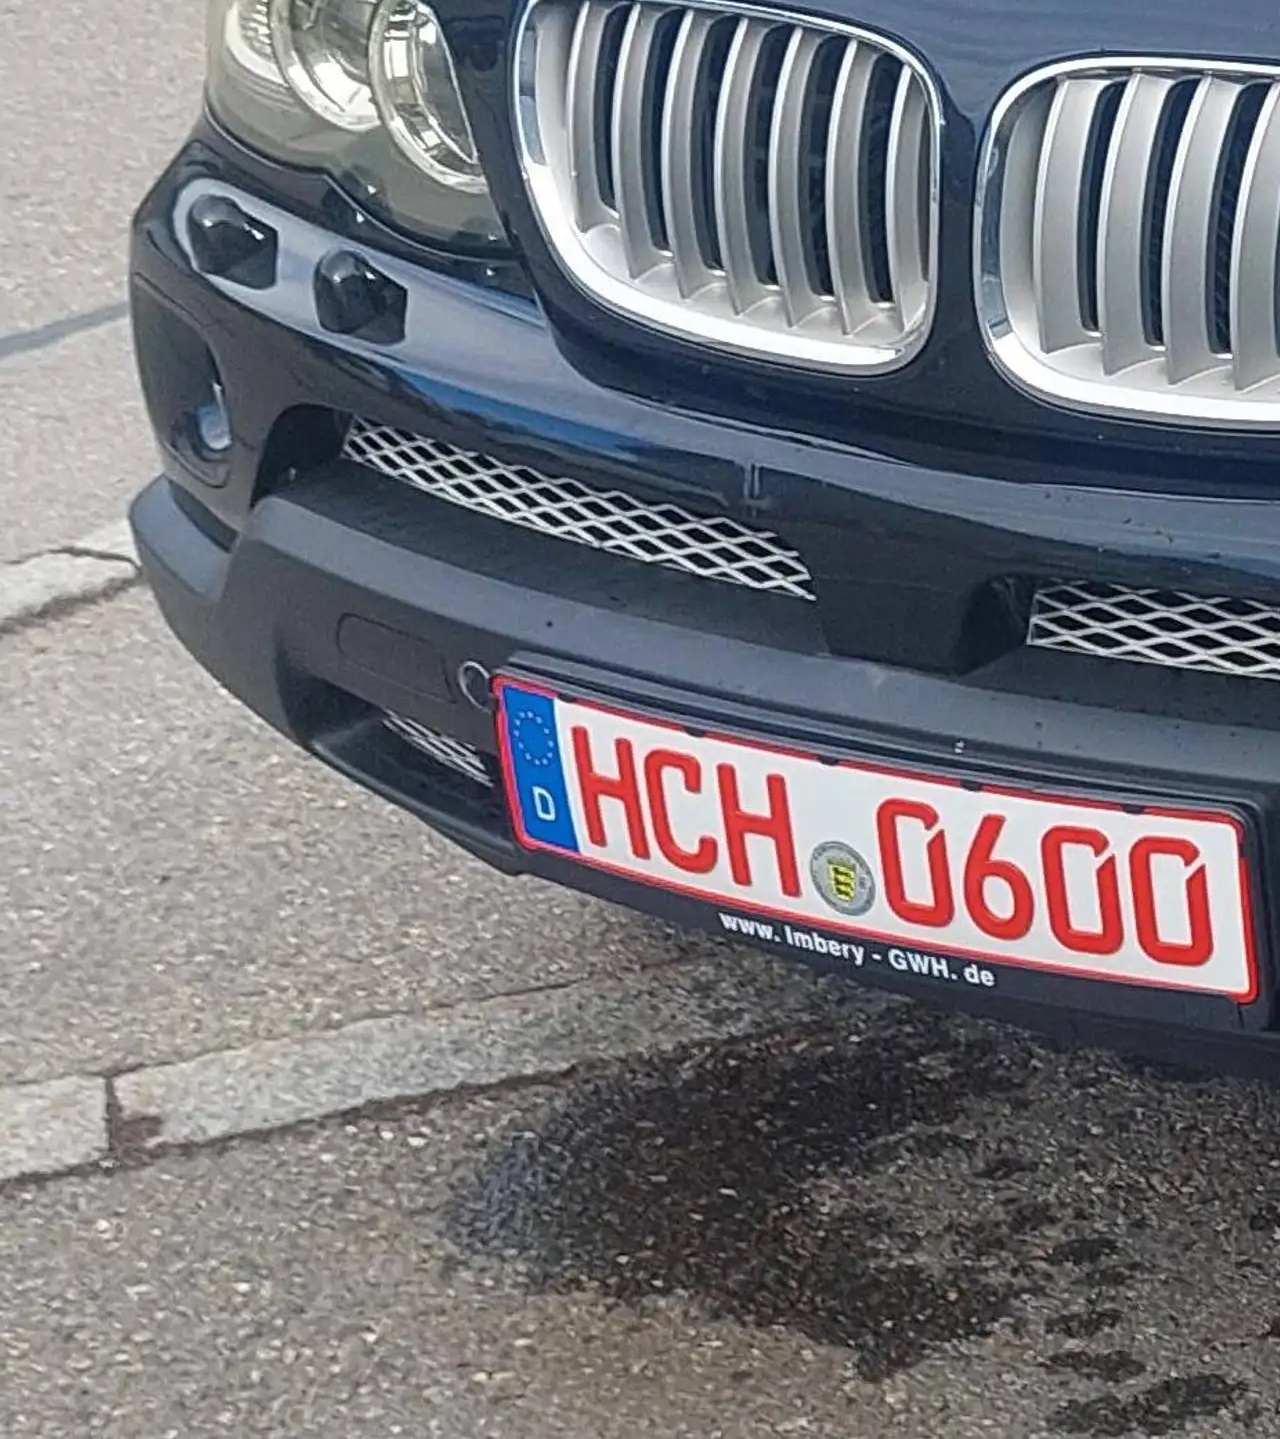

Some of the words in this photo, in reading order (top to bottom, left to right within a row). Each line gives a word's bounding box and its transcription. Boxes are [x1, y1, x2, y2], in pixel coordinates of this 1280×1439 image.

[531, 785, 556, 821] D
[571, 725, 802, 898] HCH
[876, 797, 1214, 967] 0600
[718, 912, 781, 942] www.
[785, 925, 865, 966] Imbery
[887, 948, 957, 980] GWH.
[963, 963, 996, 987] de
